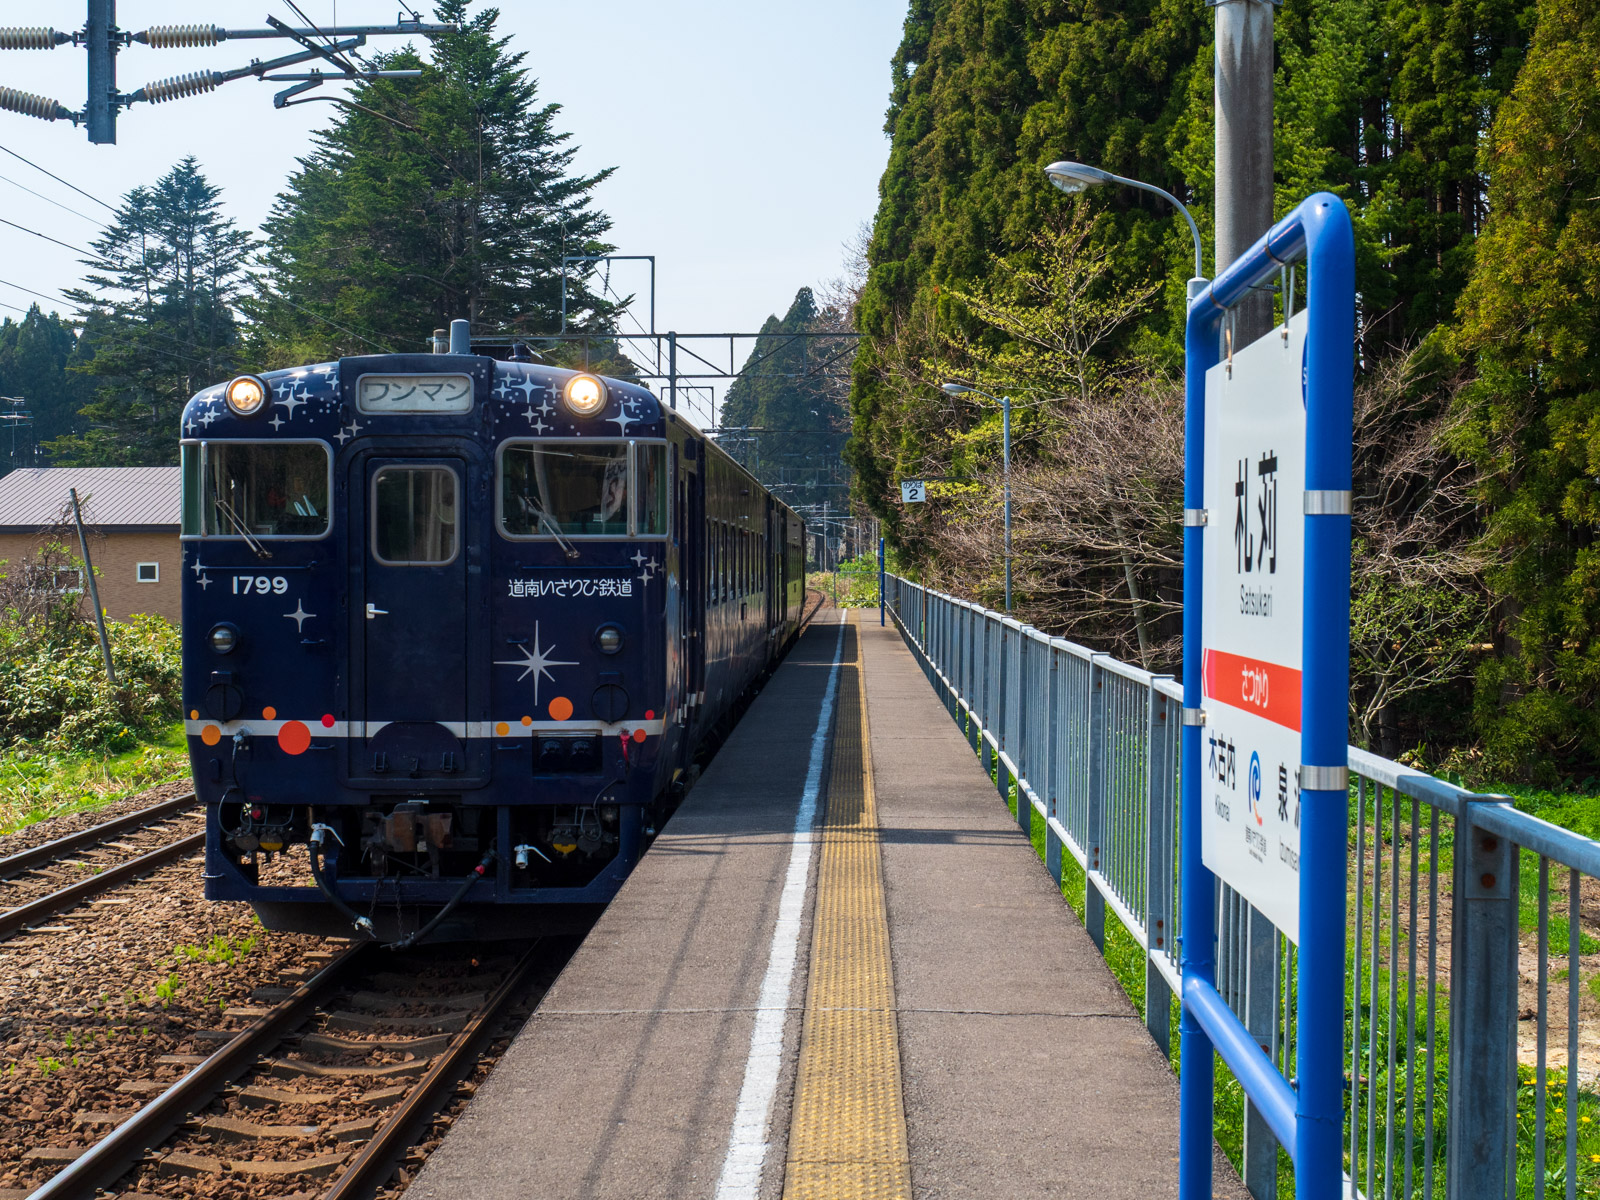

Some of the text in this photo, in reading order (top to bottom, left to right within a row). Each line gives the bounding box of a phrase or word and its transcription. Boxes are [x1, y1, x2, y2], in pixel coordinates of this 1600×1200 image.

[364, 383, 470, 402] ワンマン
[909, 489, 918, 499] 2
[1235, 449, 1278, 574] 札刈
[233, 576, 288, 595] 1799
[508, 578, 633, 597] 道南いさりび鉄道
[1240, 584, 1273, 617] Satsukari
[1241, 664, 1269, 708] さつかり
[1209, 729, 1235, 790] 木古内
[1279, 834, 1300, 872] Izumisa
